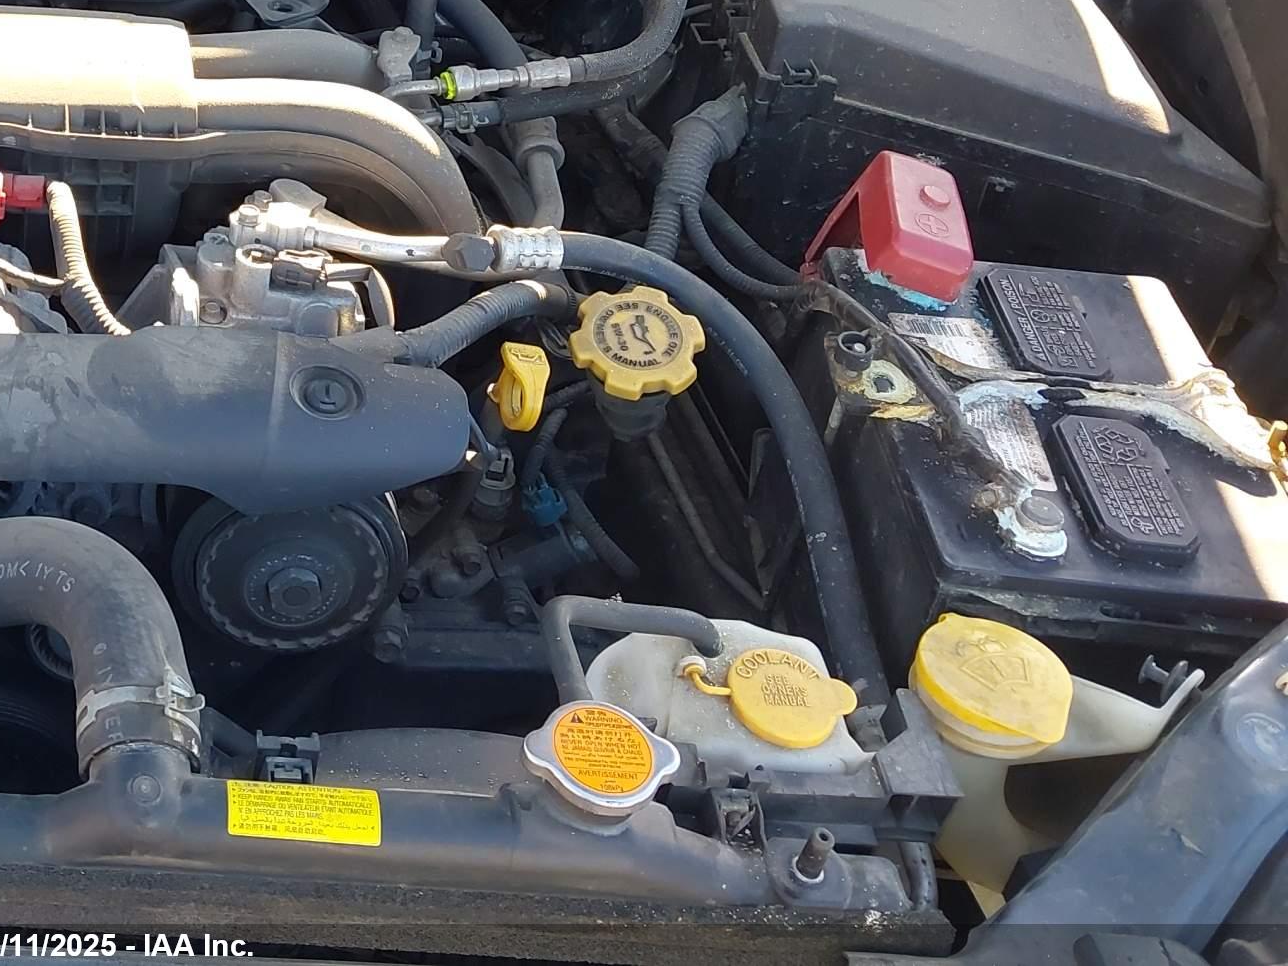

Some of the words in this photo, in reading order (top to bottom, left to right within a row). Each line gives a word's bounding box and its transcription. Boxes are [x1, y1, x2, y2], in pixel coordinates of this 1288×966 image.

[615, 301, 640, 313] SEE
[646, 304, 680, 339] ENGINE
[610, 322, 629, 352] 5W-30
[661, 340, 679, 358] OIL
[611, 352, 663, 368] MANUAL
[735, 649, 820, 681] COOLANT
[764, 673, 792, 684] SEE
[763, 694, 812, 708] MANUAL
[583, 715, 623, 725] WARNING
[578, 768, 638, 781] AVERTISSEMENT
